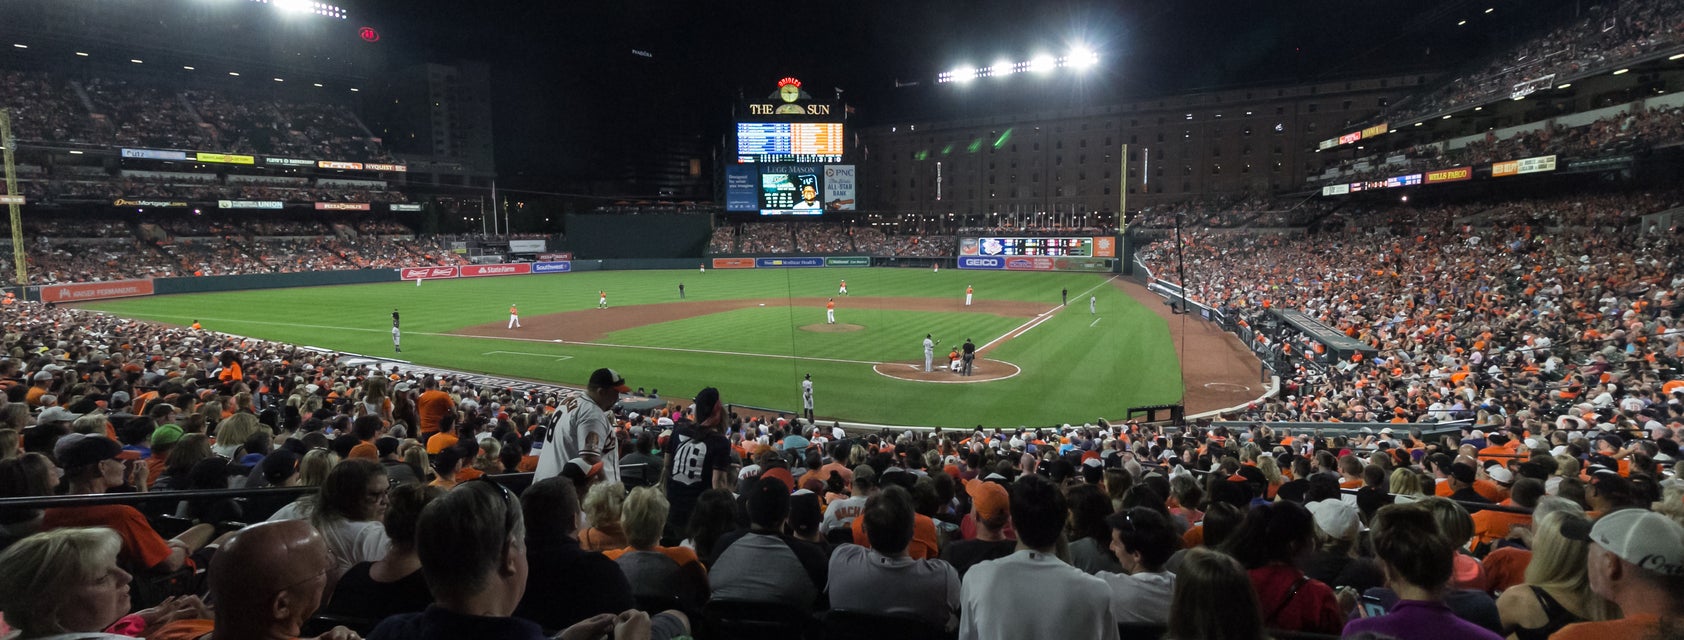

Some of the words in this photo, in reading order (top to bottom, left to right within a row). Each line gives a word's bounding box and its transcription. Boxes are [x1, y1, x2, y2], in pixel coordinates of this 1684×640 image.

[777, 77, 801, 88] ORIOLES
[750, 104, 774, 114] THE
[807, 104, 830, 114] SUN
[365, 163, 392, 171] NYQUIST
[836, 169, 854, 177] PNC
[1428, 172, 1447, 181] WELLS
[1447, 169, 1467, 179] FARGO
[965, 258, 998, 267] GEICO
[546, 409, 563, 443] 8
